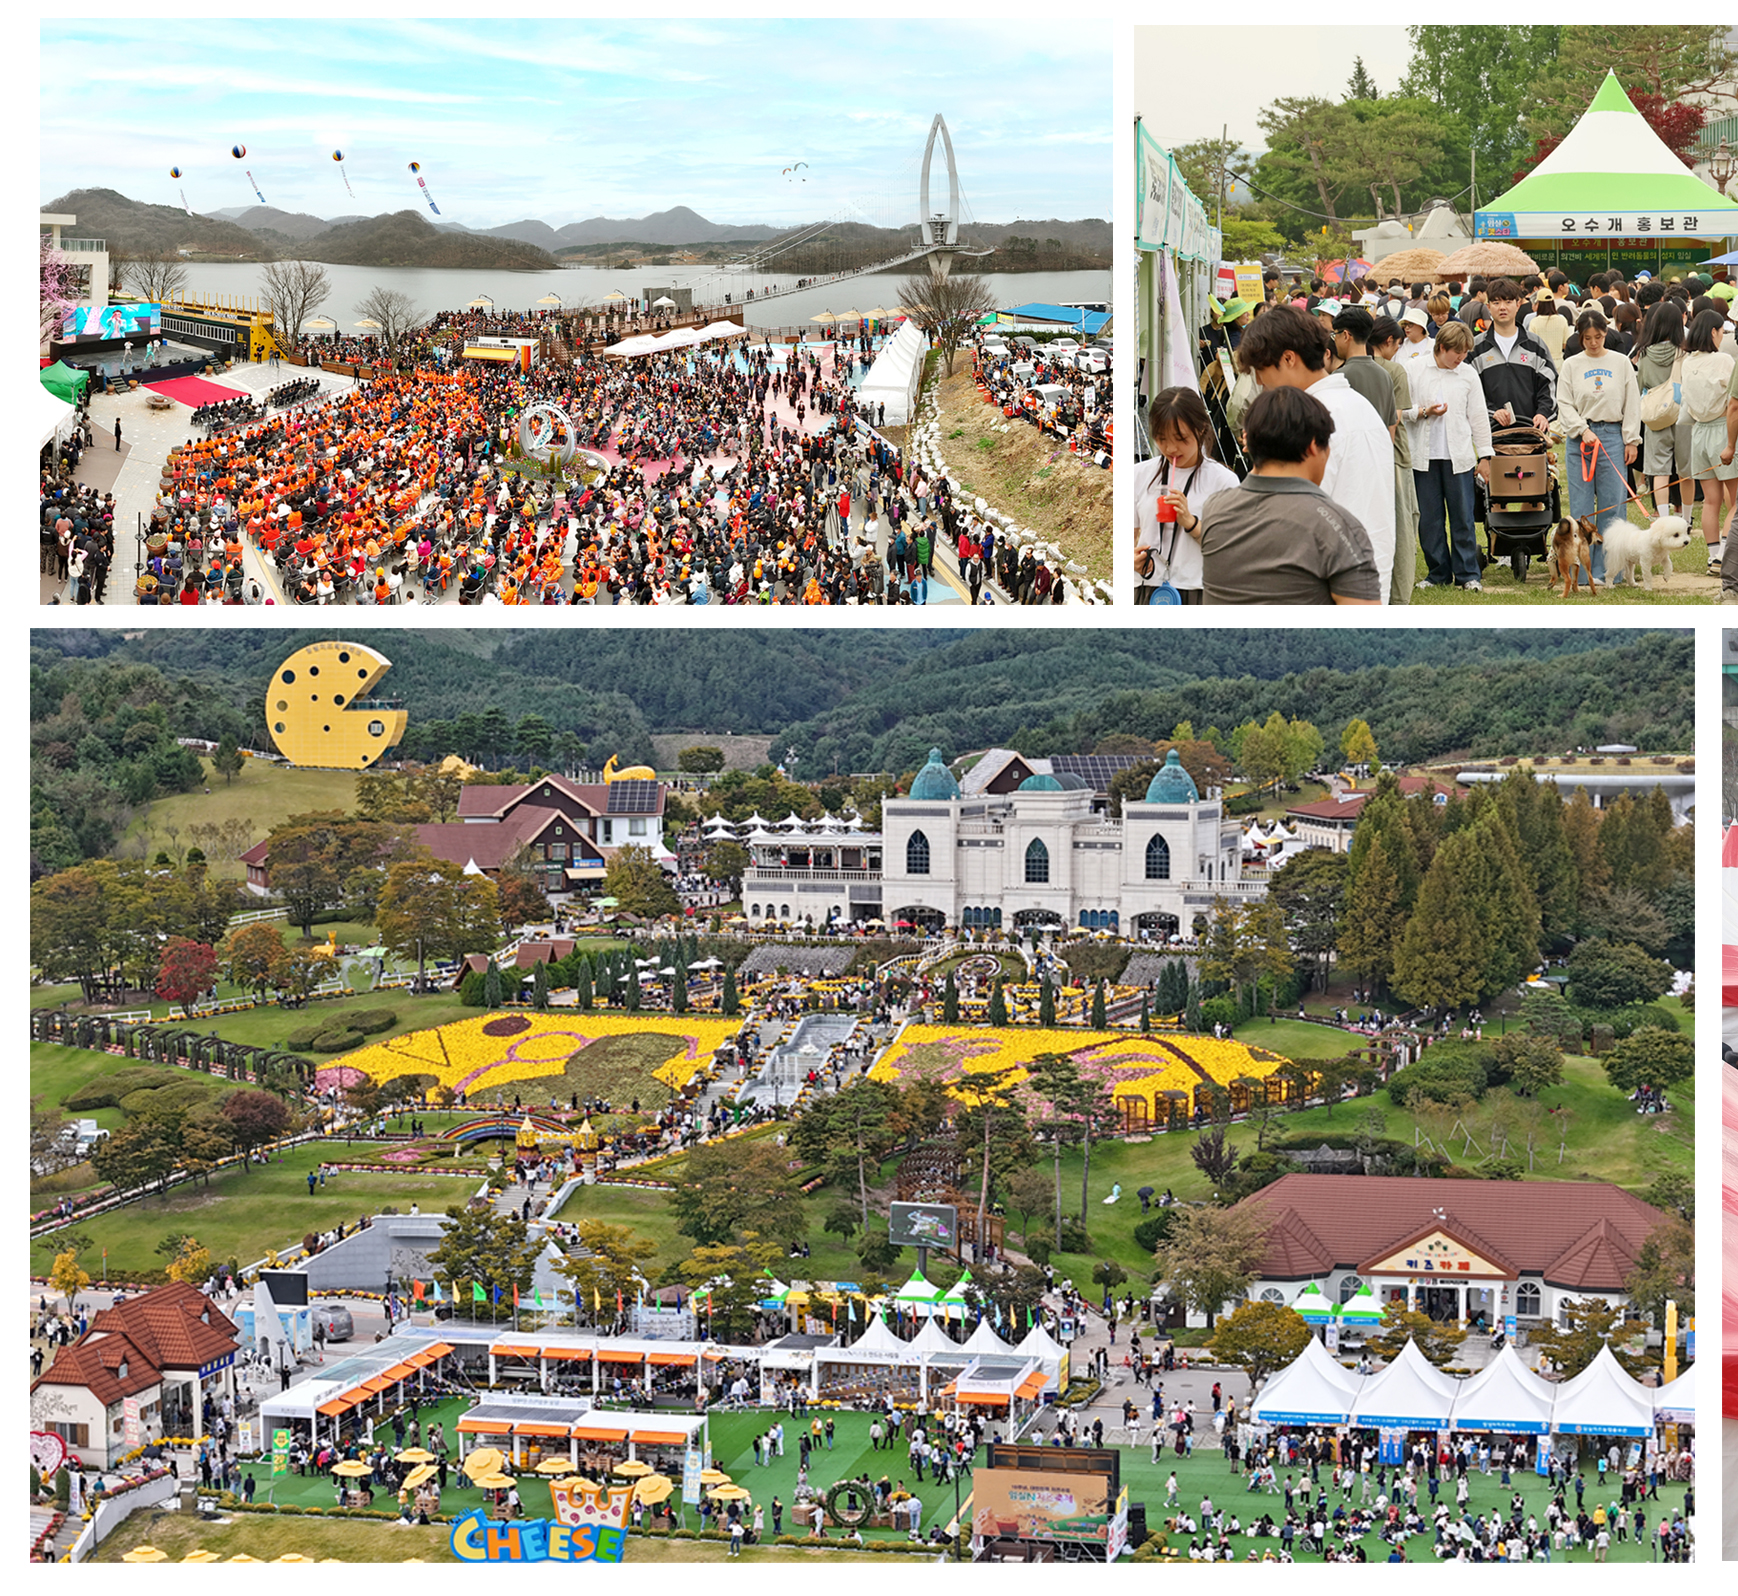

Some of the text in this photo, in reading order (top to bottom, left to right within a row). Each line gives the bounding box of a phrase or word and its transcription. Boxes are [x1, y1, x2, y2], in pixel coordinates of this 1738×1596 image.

[1561, 216, 1698, 233] 오수개 홍보관
[1584, 368, 1613, 380] RECEIVE
[1326, 515, 1342, 532] LIKE
[453, 1515, 622, 1563] CHEESE
